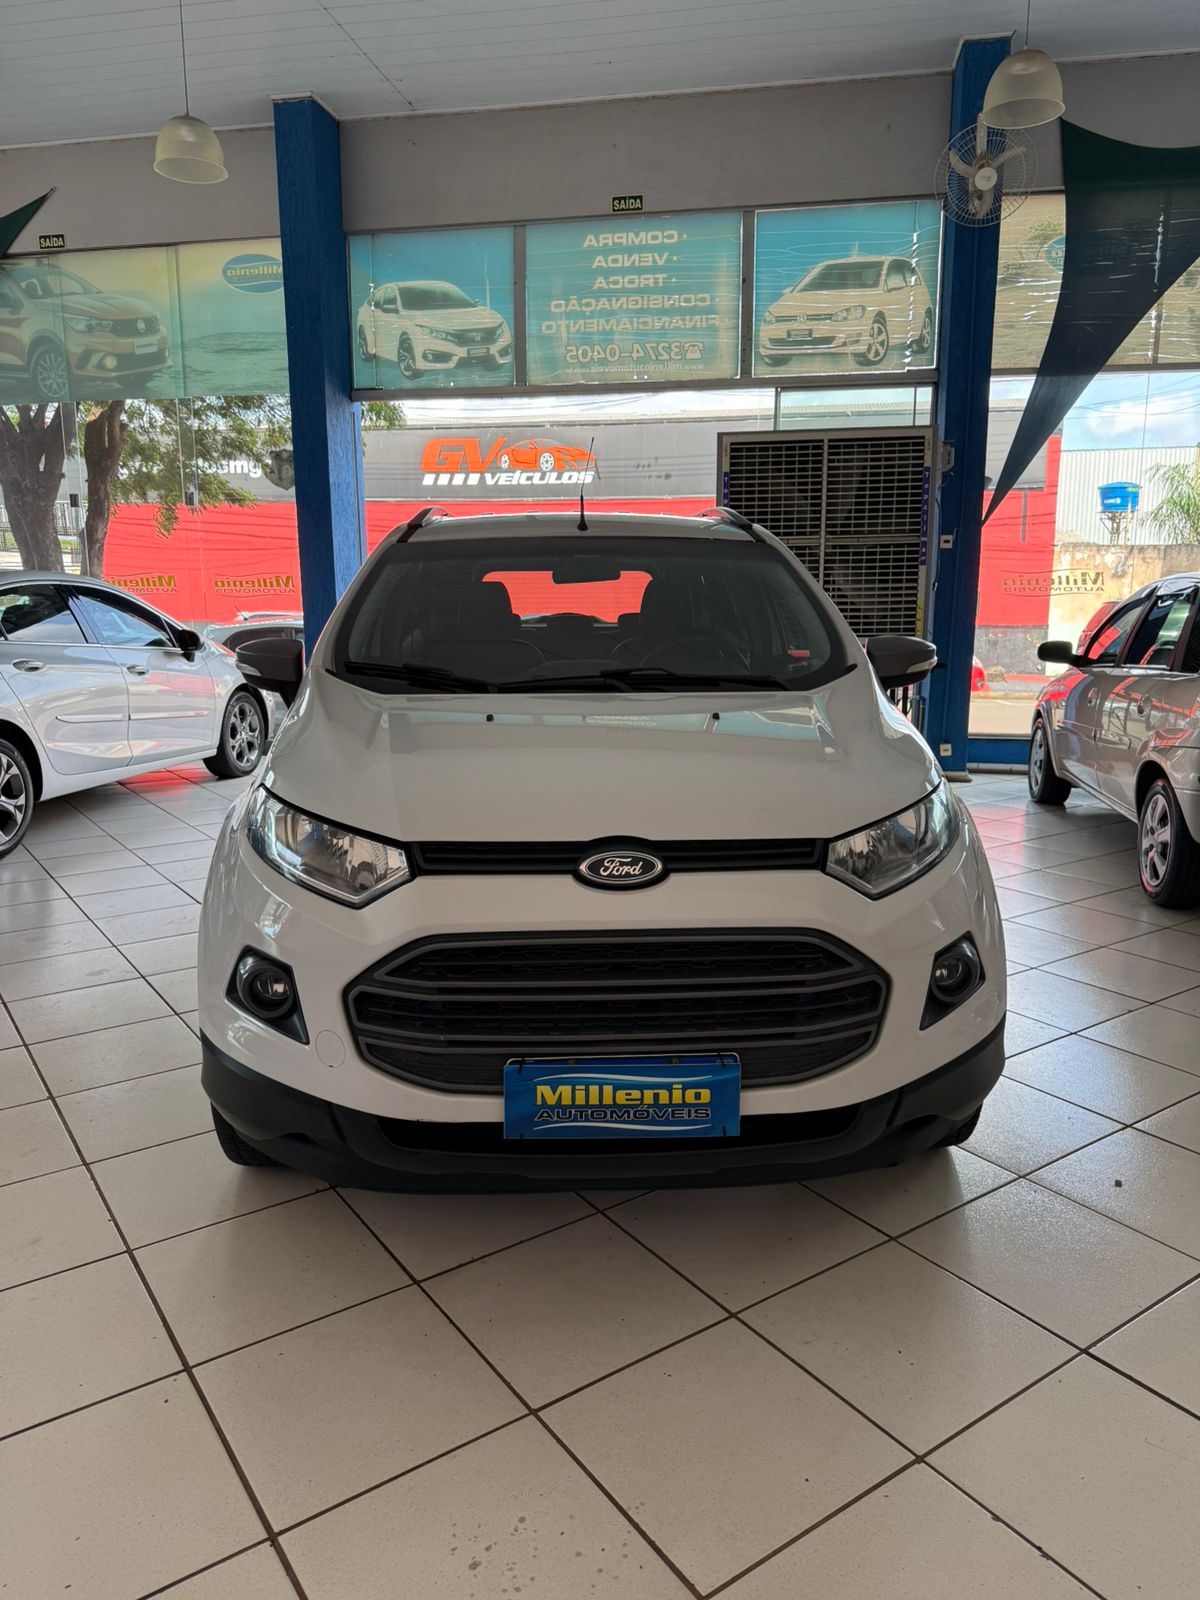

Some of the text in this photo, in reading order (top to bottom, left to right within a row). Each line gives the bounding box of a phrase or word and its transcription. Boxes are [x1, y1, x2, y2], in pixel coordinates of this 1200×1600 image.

[613, 197, 642, 210] SAÍDA
[40, 236, 64, 248] SAÍDA
[420, 436, 508, 473] GV
[600, 857, 643, 877] Ford
[535, 1083, 712, 1106] Millenio
[534, 1105, 712, 1121] AUTOMÓVEIS
